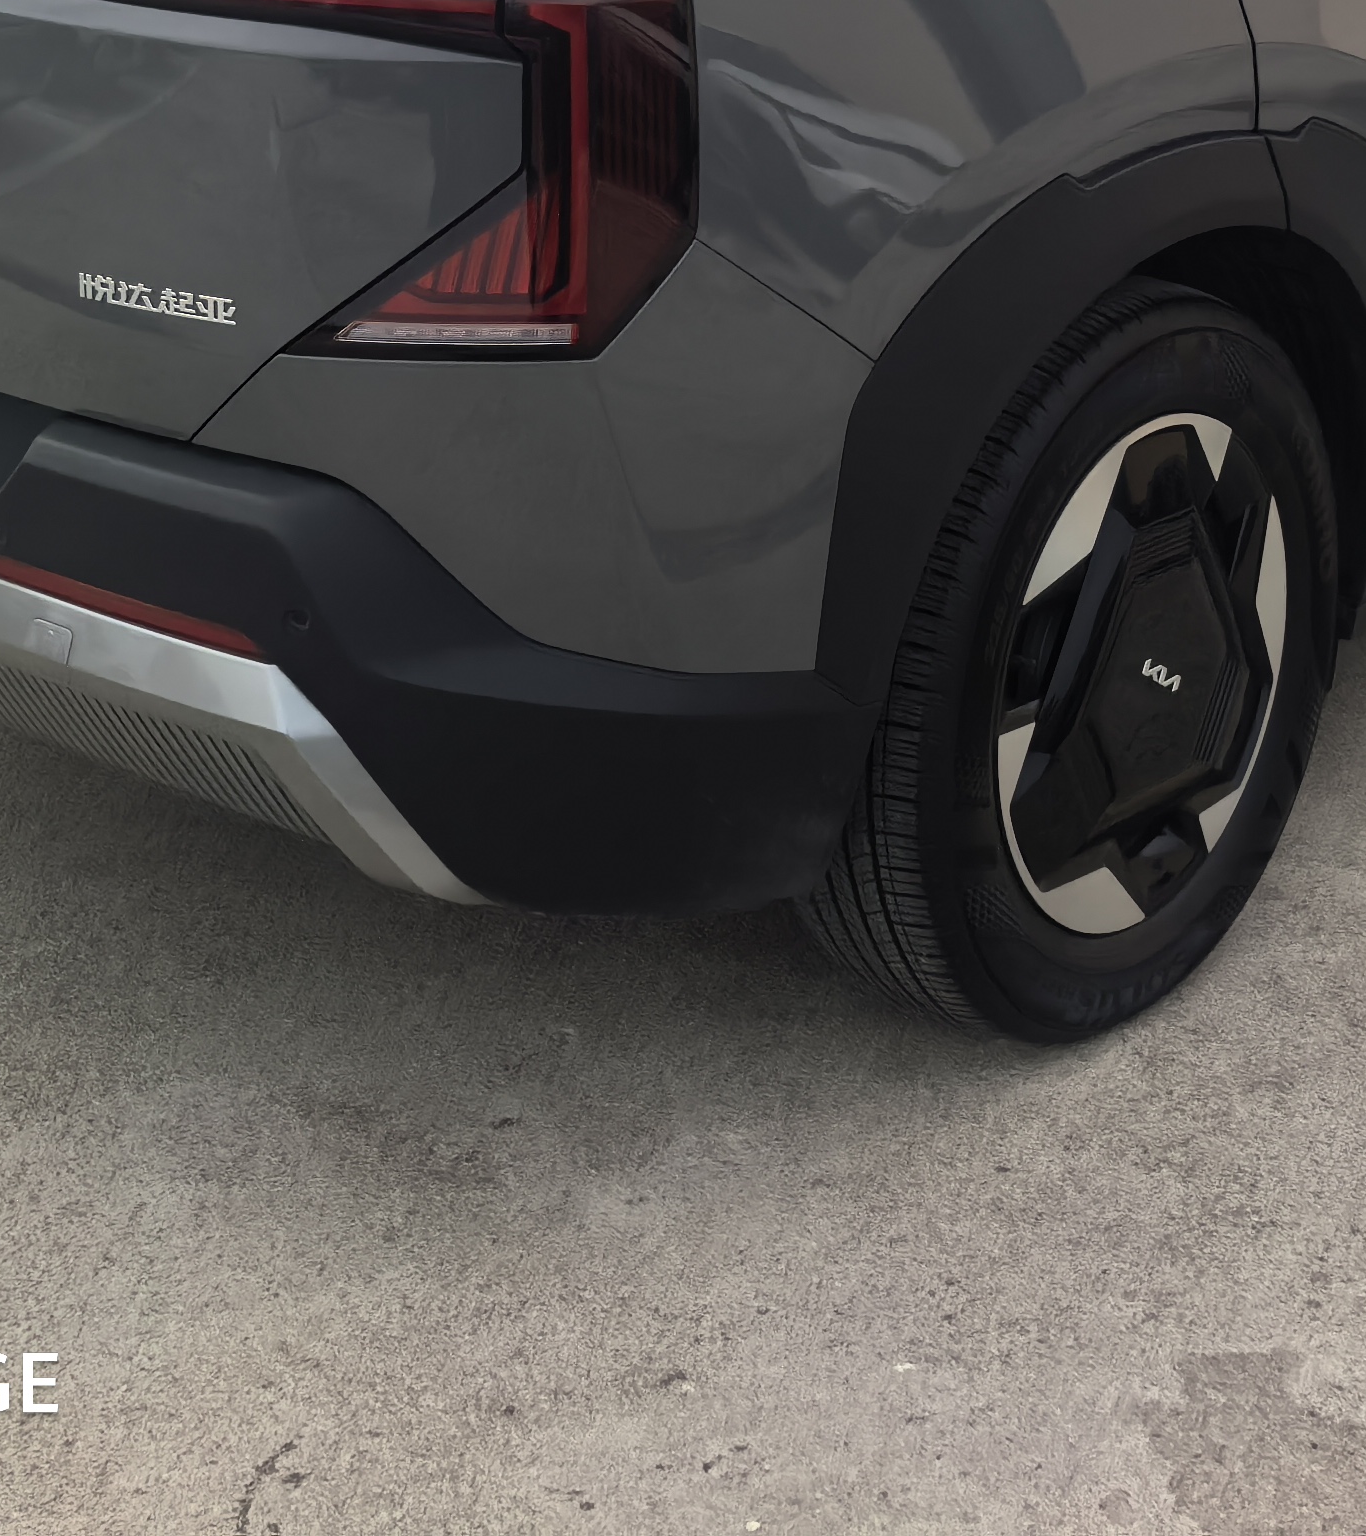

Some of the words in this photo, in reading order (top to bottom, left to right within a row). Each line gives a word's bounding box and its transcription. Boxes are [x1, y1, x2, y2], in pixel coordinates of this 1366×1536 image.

[78, 272, 237, 326] 悦达起亚
[1141, 658, 1182, 693] KIA
